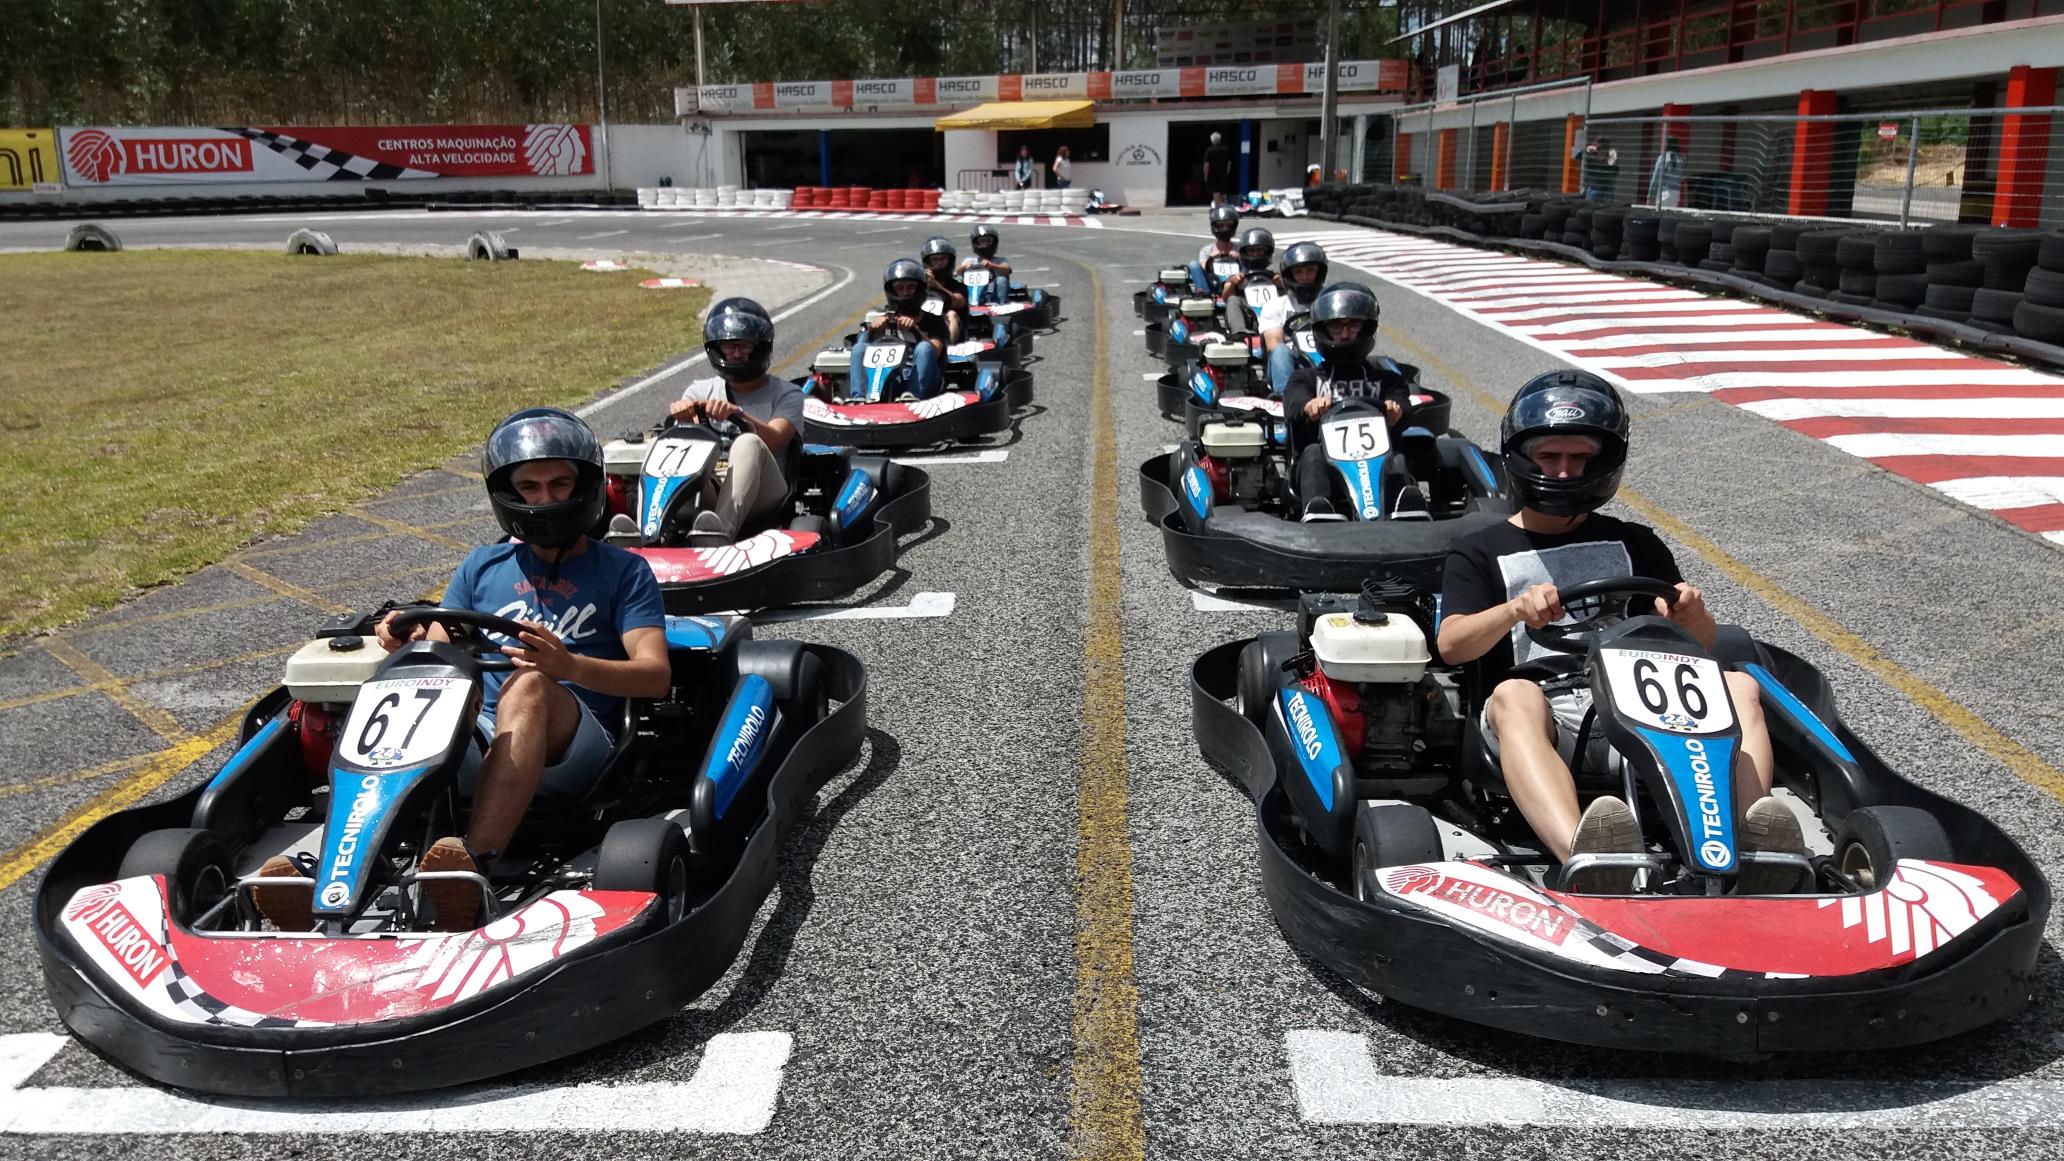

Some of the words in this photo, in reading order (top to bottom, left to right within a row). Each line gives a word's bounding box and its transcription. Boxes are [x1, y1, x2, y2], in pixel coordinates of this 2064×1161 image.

[1209, 70, 1256, 82] HASCO
[1308, 66, 1358, 78] HACO
[939, 80, 980, 91] HASCO
[1025, 77, 1068, 89] HASCO
[1115, 74, 1160, 86] HASCO
[701, 87, 737, 98] HASCO
[777, 86, 815, 96] HASCO
[856, 83, 896, 94] HASCO
[378, 139, 434, 151] CENTROS
[437, 136, 517, 151] MAQUINAÇÃO
[135, 142, 243, 170] HURON
[409, 154, 440, 165] ALTA
[442, 153, 516, 164] VELOCIDADE
[1253, 288, 1271, 302] 70
[871, 348, 897, 363] 68
[1335, 423, 1375, 454] 75
[658, 445, 693, 471] 71
[1619, 650, 1700, 665] EUROINDY
[375, 679, 454, 690] EUROINDY
[1633, 659, 1708, 721] 66
[357, 689, 443, 756] 67
[1287, 691, 1322, 760] TECNIROLO
[726, 705, 766, 772] TECNIROLO
[1685, 739, 1723, 839] TECNIROLO
[331, 775, 380, 881] TECNIROLO
[1445, 881, 1563, 938] HURON
[95, 908, 164, 980] HURON
